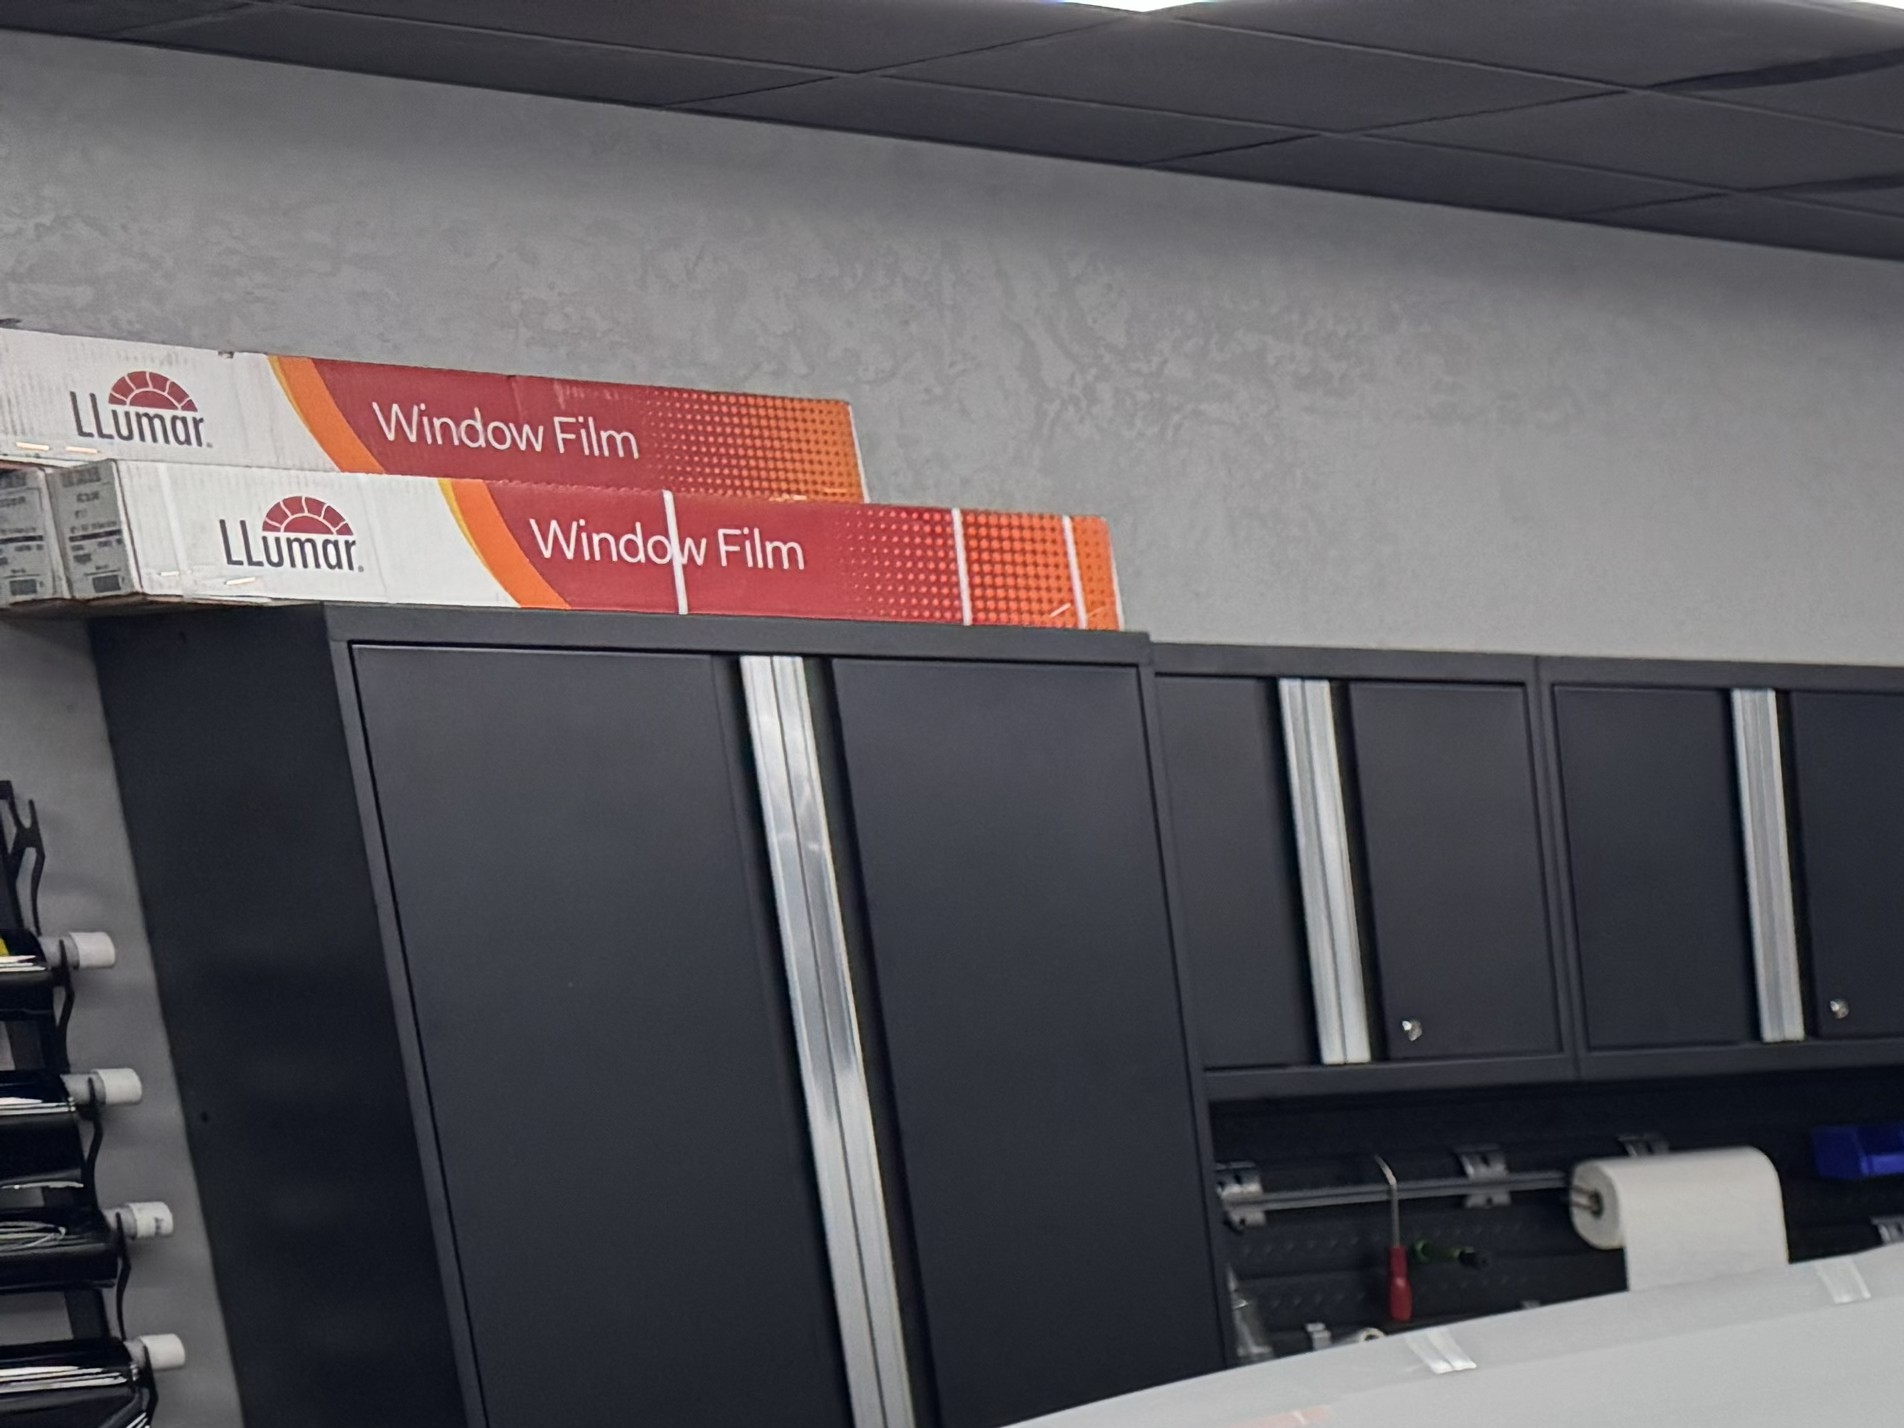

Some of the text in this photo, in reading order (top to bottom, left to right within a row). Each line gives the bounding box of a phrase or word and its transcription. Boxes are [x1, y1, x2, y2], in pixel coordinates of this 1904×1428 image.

[70, 391, 205, 447] LLumar
[372, 401, 640, 459] Window Film
[219, 519, 357, 571] LLumar
[530, 518, 805, 570] Window Film
